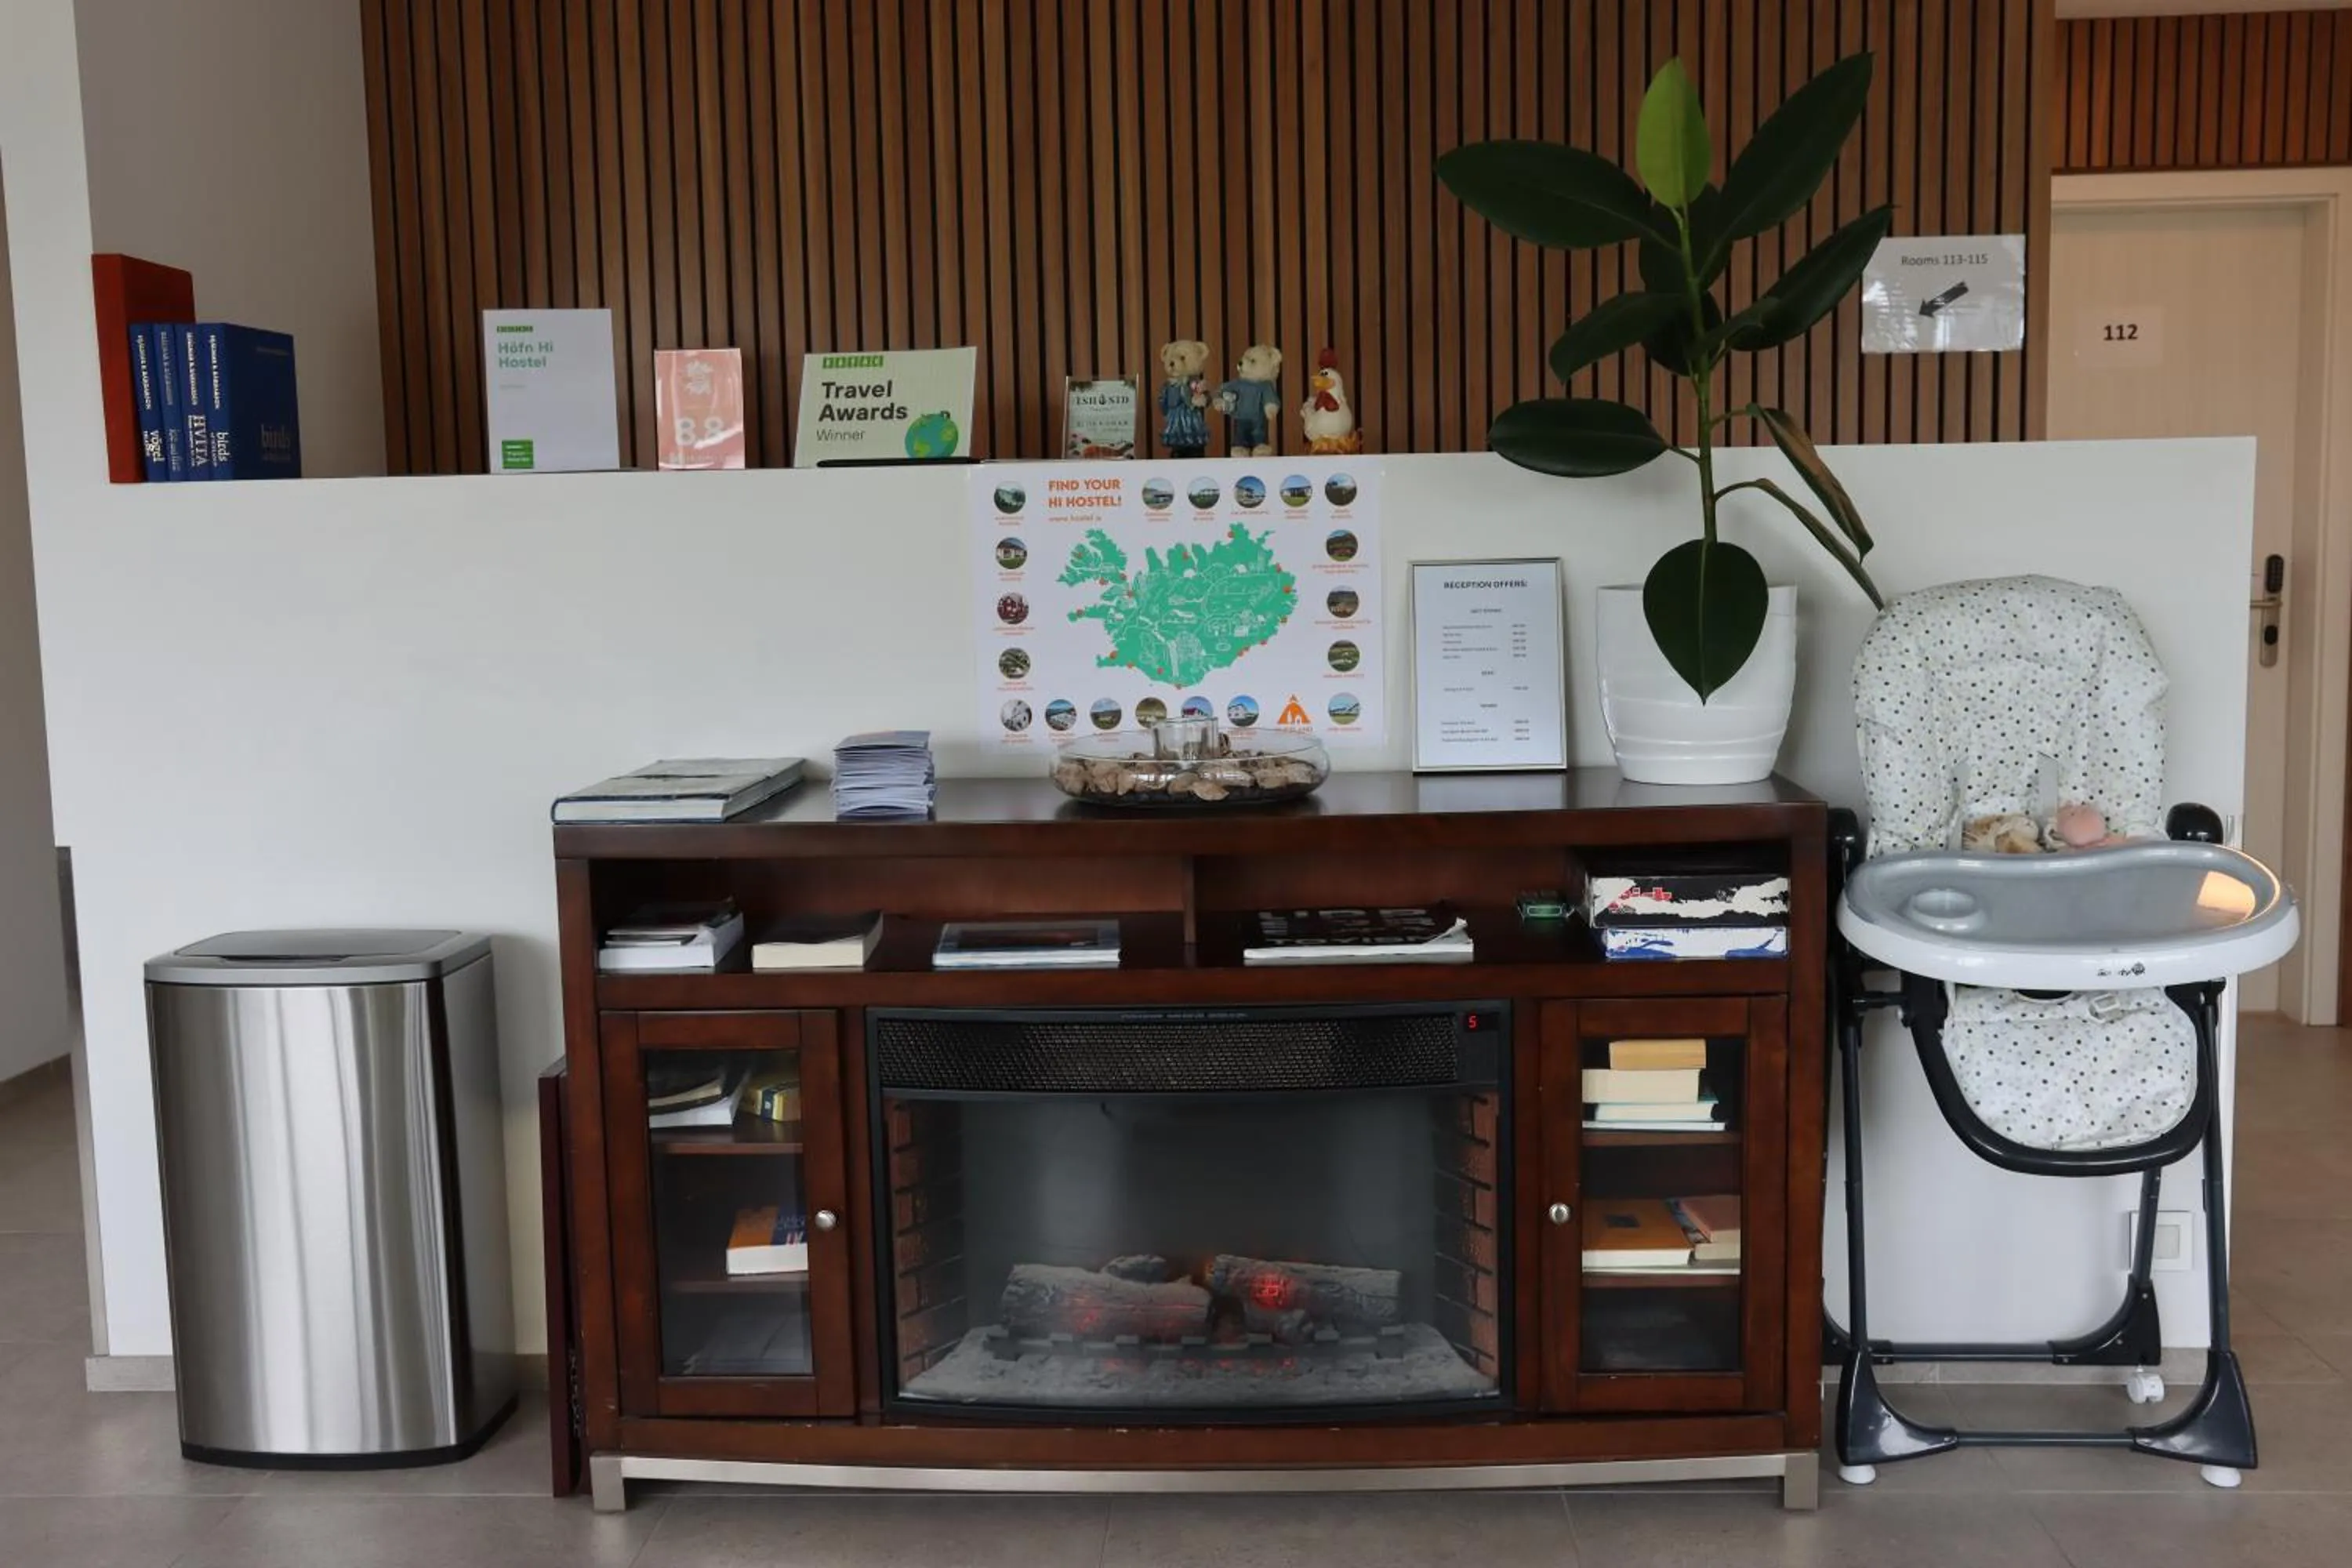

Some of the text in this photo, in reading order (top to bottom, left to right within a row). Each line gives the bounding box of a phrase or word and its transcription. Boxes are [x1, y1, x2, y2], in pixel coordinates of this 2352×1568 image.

[1901, 252, 1989, 266] Rooms 113-115
[2103, 323, 2139, 341] 112
[498, 339, 554, 354] Höfn Hi
[499, 355, 547, 368] Hostel
[821, 379, 893, 398] Travel
[818, 402, 909, 422] Awards
[816, 429, 866, 441] Winner
[1048, 478, 1121, 492] FIND YOUR
[1048, 495, 1122, 508] HI HOSTEL!
[1443, 580, 1491, 589] RECEPTION
